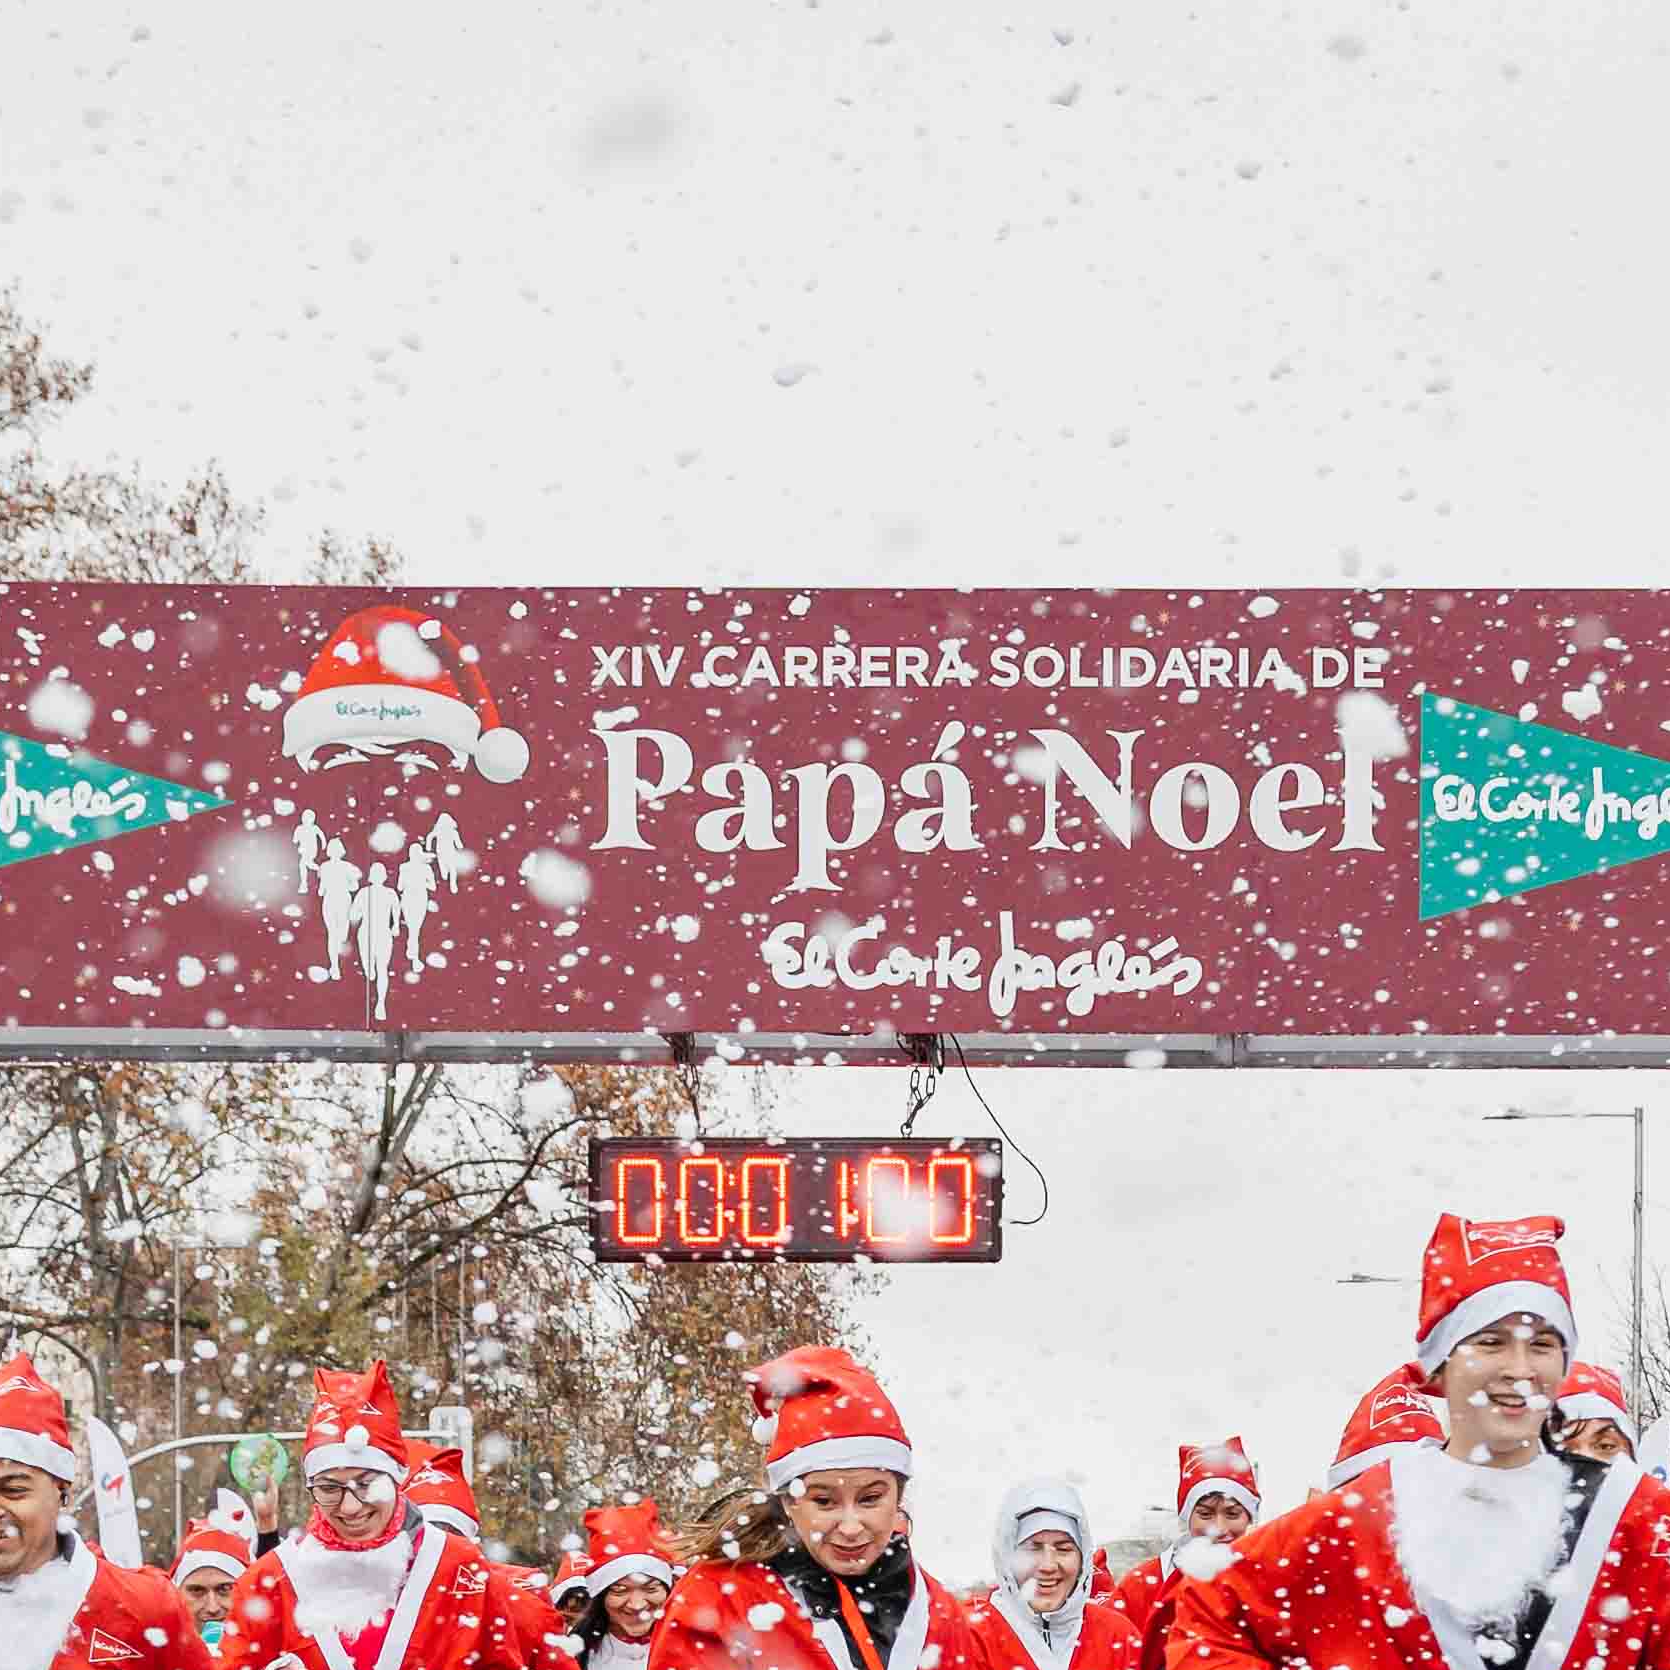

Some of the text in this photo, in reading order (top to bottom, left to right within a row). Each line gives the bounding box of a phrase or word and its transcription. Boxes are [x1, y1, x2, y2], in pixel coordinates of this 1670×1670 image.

[592, 647, 1384, 688] XIV CARRERA SOLIDARIA DE
[590, 721, 1387, 892] Papá Noel
[1433, 774, 1477, 821] El
[1480, 777, 1579, 822] Corte
[766, 911, 1202, 1017] El Corte Inglés
